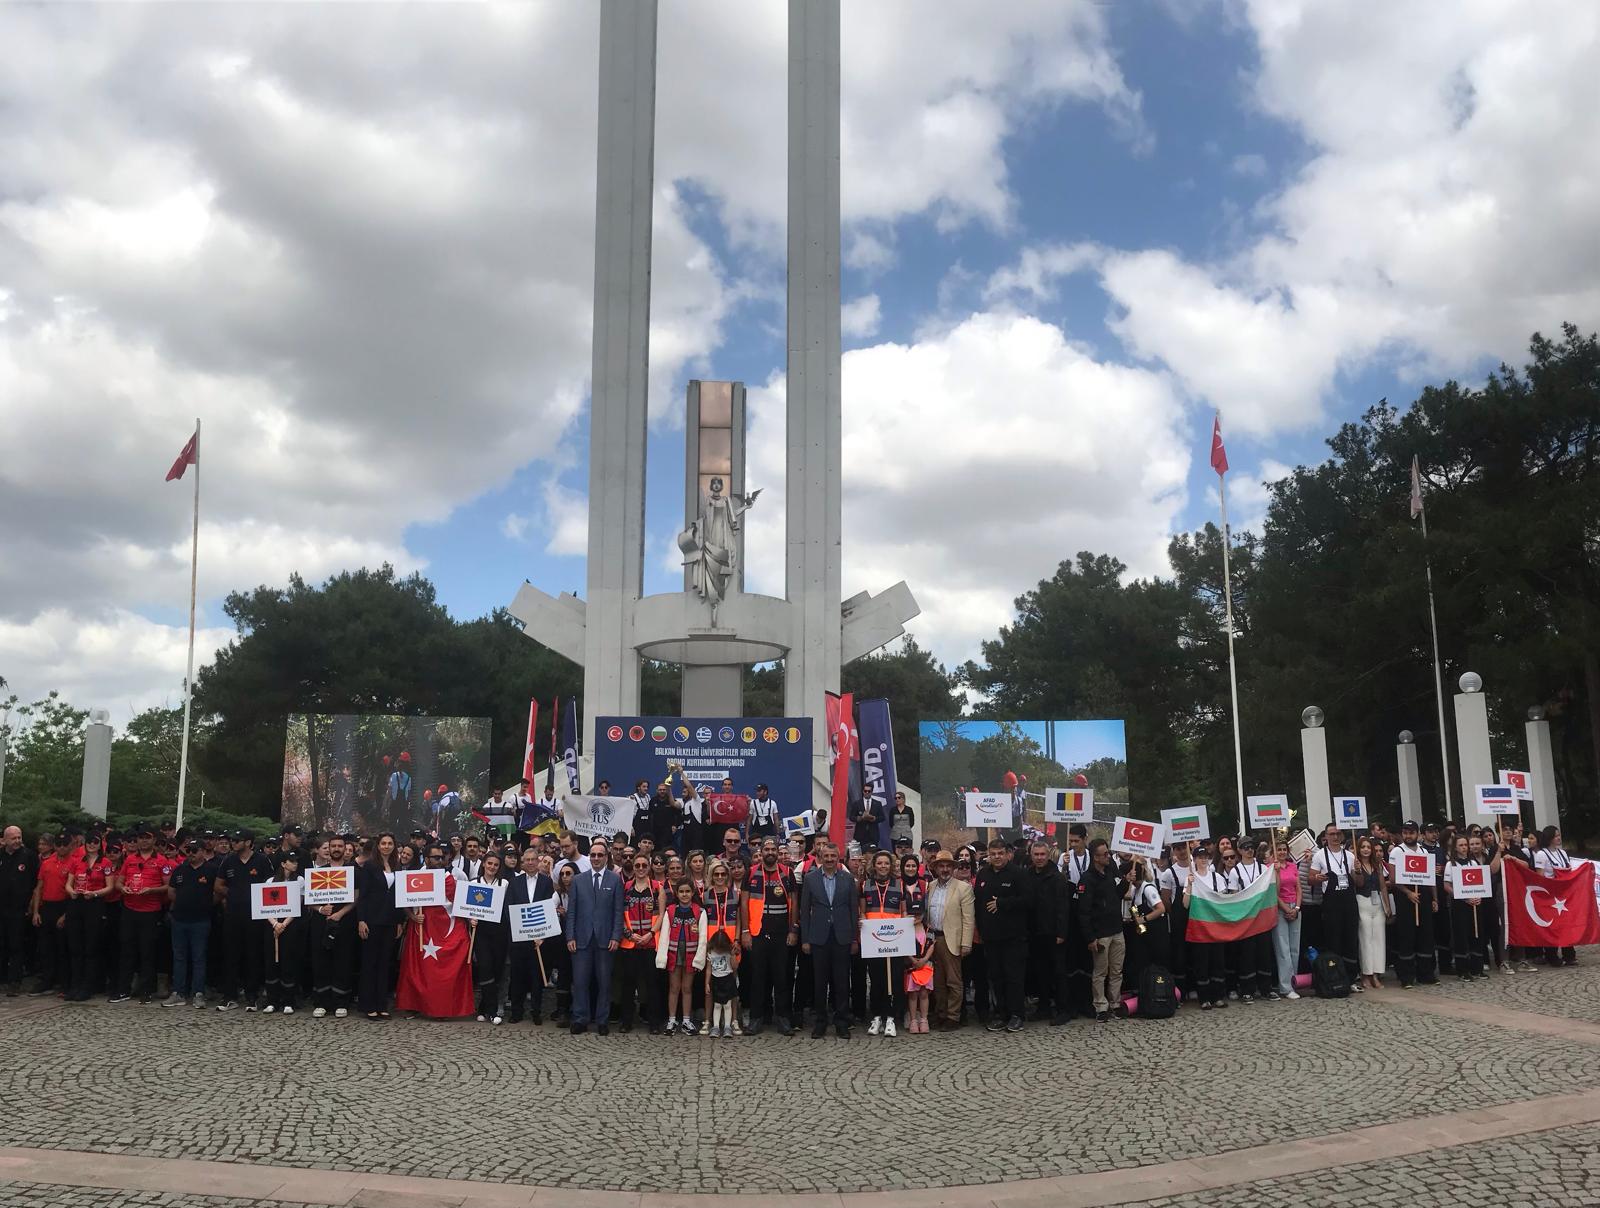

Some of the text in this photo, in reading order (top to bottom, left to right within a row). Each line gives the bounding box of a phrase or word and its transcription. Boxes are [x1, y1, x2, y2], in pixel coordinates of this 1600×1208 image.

[655, 746, 757, 757] BALKAN ÜLKELERİ ÜNİVERSİTELER ARASI
[687, 758, 715, 767] KURTARMA
[717, 759, 745, 768] YARIŞMASI
[593, 814, 609, 824] IUS
